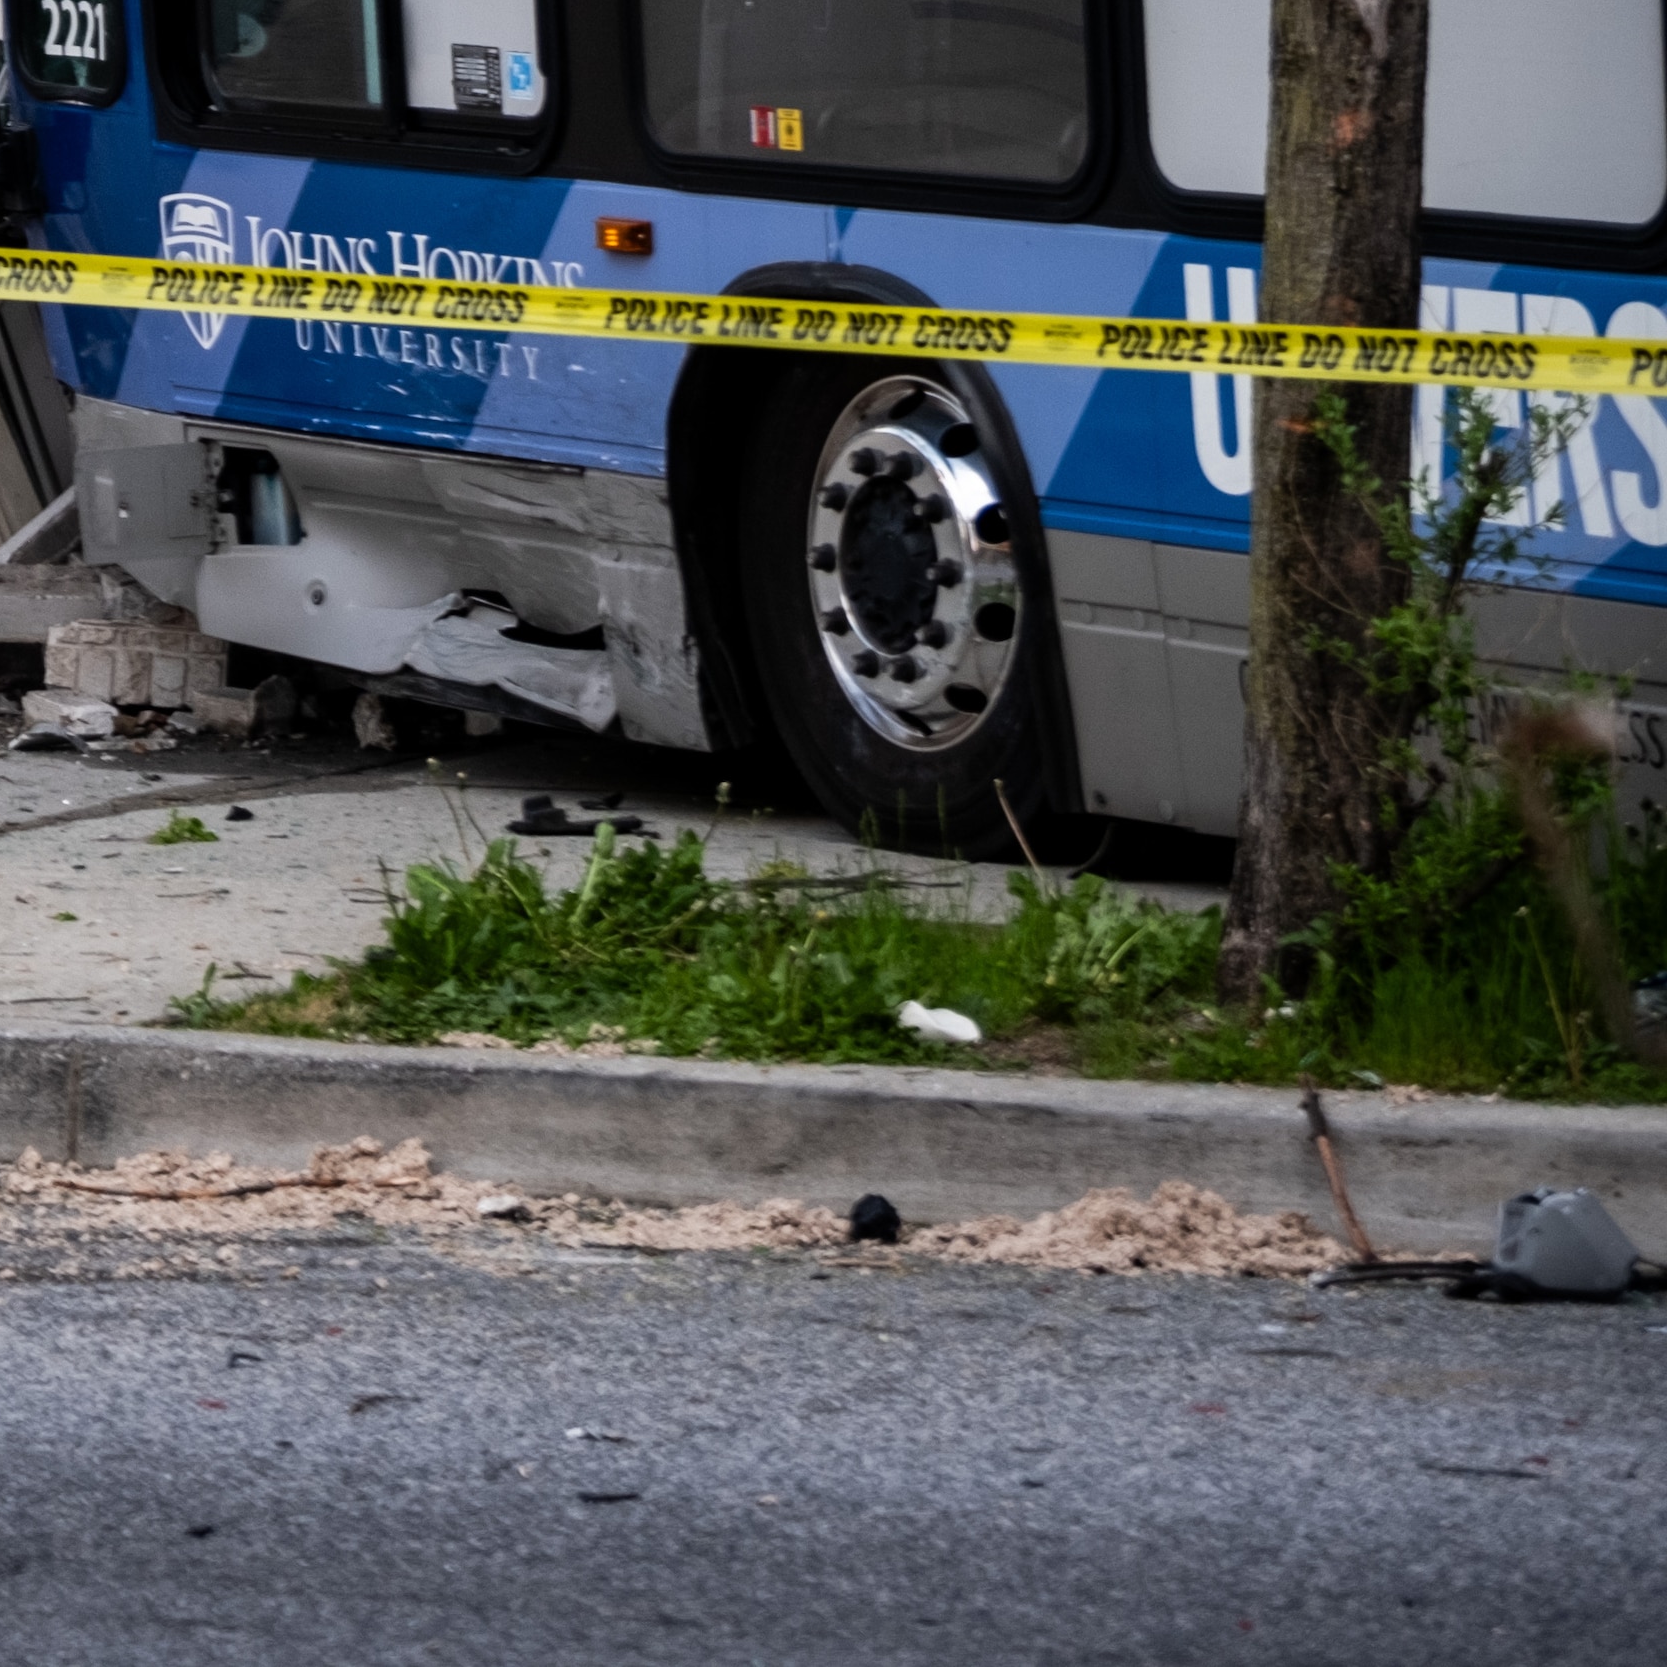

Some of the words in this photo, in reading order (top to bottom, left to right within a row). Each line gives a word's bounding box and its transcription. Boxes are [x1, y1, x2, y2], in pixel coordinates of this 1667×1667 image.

[147, 266, 244, 305] POLICE
[252, 273, 314, 310] LINE
[320, 278, 361, 314] DO
[367, 281, 427, 316] NOT
[434, 285, 529, 323] CROSS
[293, 318, 540, 381] UNIVERSITY
[605, 297, 710, 333] POLICE
[717, 303, 784, 339] LINE
[792, 309, 835, 342] DO
[843, 312, 904, 346] NOT
[912, 314, 1015, 353] CROSS
[1097, 323, 1209, 362] POLICE
[1218, 329, 1289, 367] LINE
[1299, 333, 1345, 370] DO
[1353, 335, 1418, 373] NOT
[1429, 338, 1539, 380] CROSS
